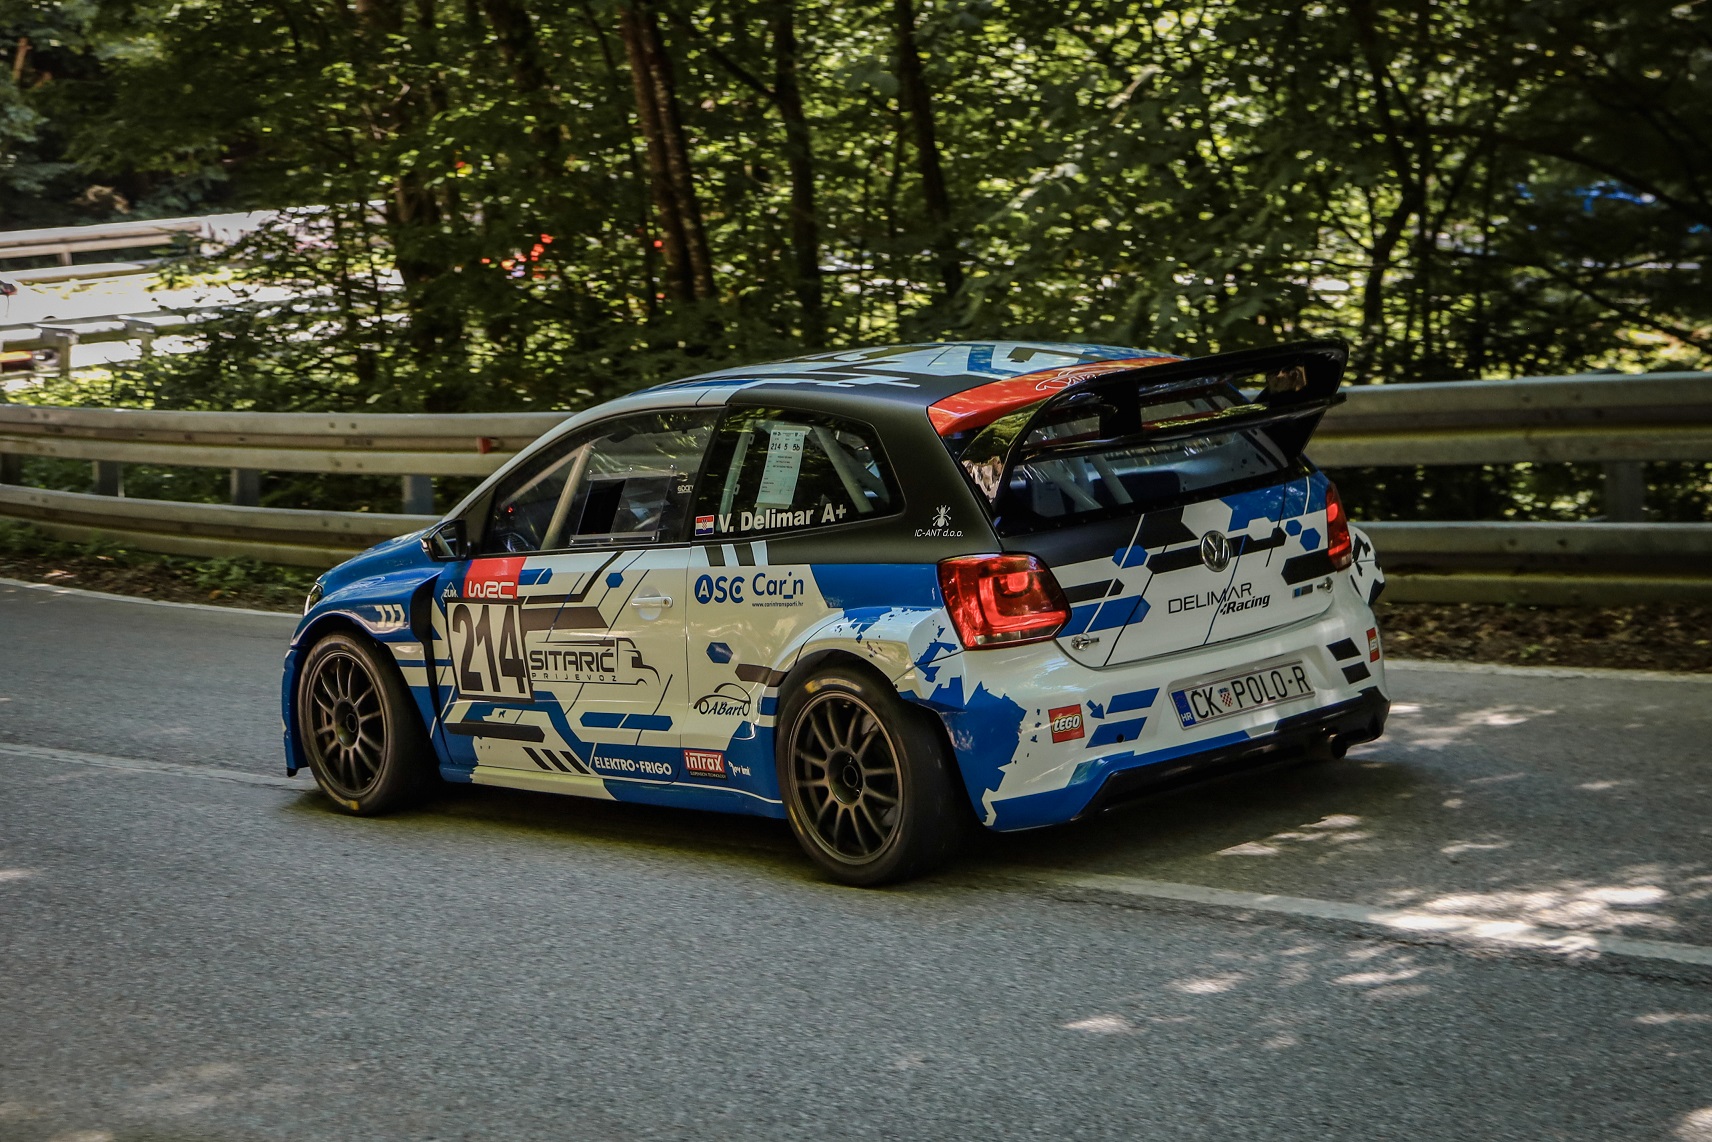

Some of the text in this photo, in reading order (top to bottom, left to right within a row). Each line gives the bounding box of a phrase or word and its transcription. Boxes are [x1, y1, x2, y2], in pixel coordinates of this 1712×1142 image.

[719, 503, 847, 533] V. Delimar A+
[914, 528, 964, 537] IC-ANT d.o.o.
[468, 581, 515, 599] WRC
[1168, 582, 1252, 614] DELIMAR
[1226, 594, 1271, 615] Racing
[453, 604, 526, 693] 214
[529, 648, 615, 673] SITARIĆ
[1190, 686, 1223, 719] ČK
[1053, 715, 1080, 732] LEGO
[1181, 712, 1193, 722] HR
